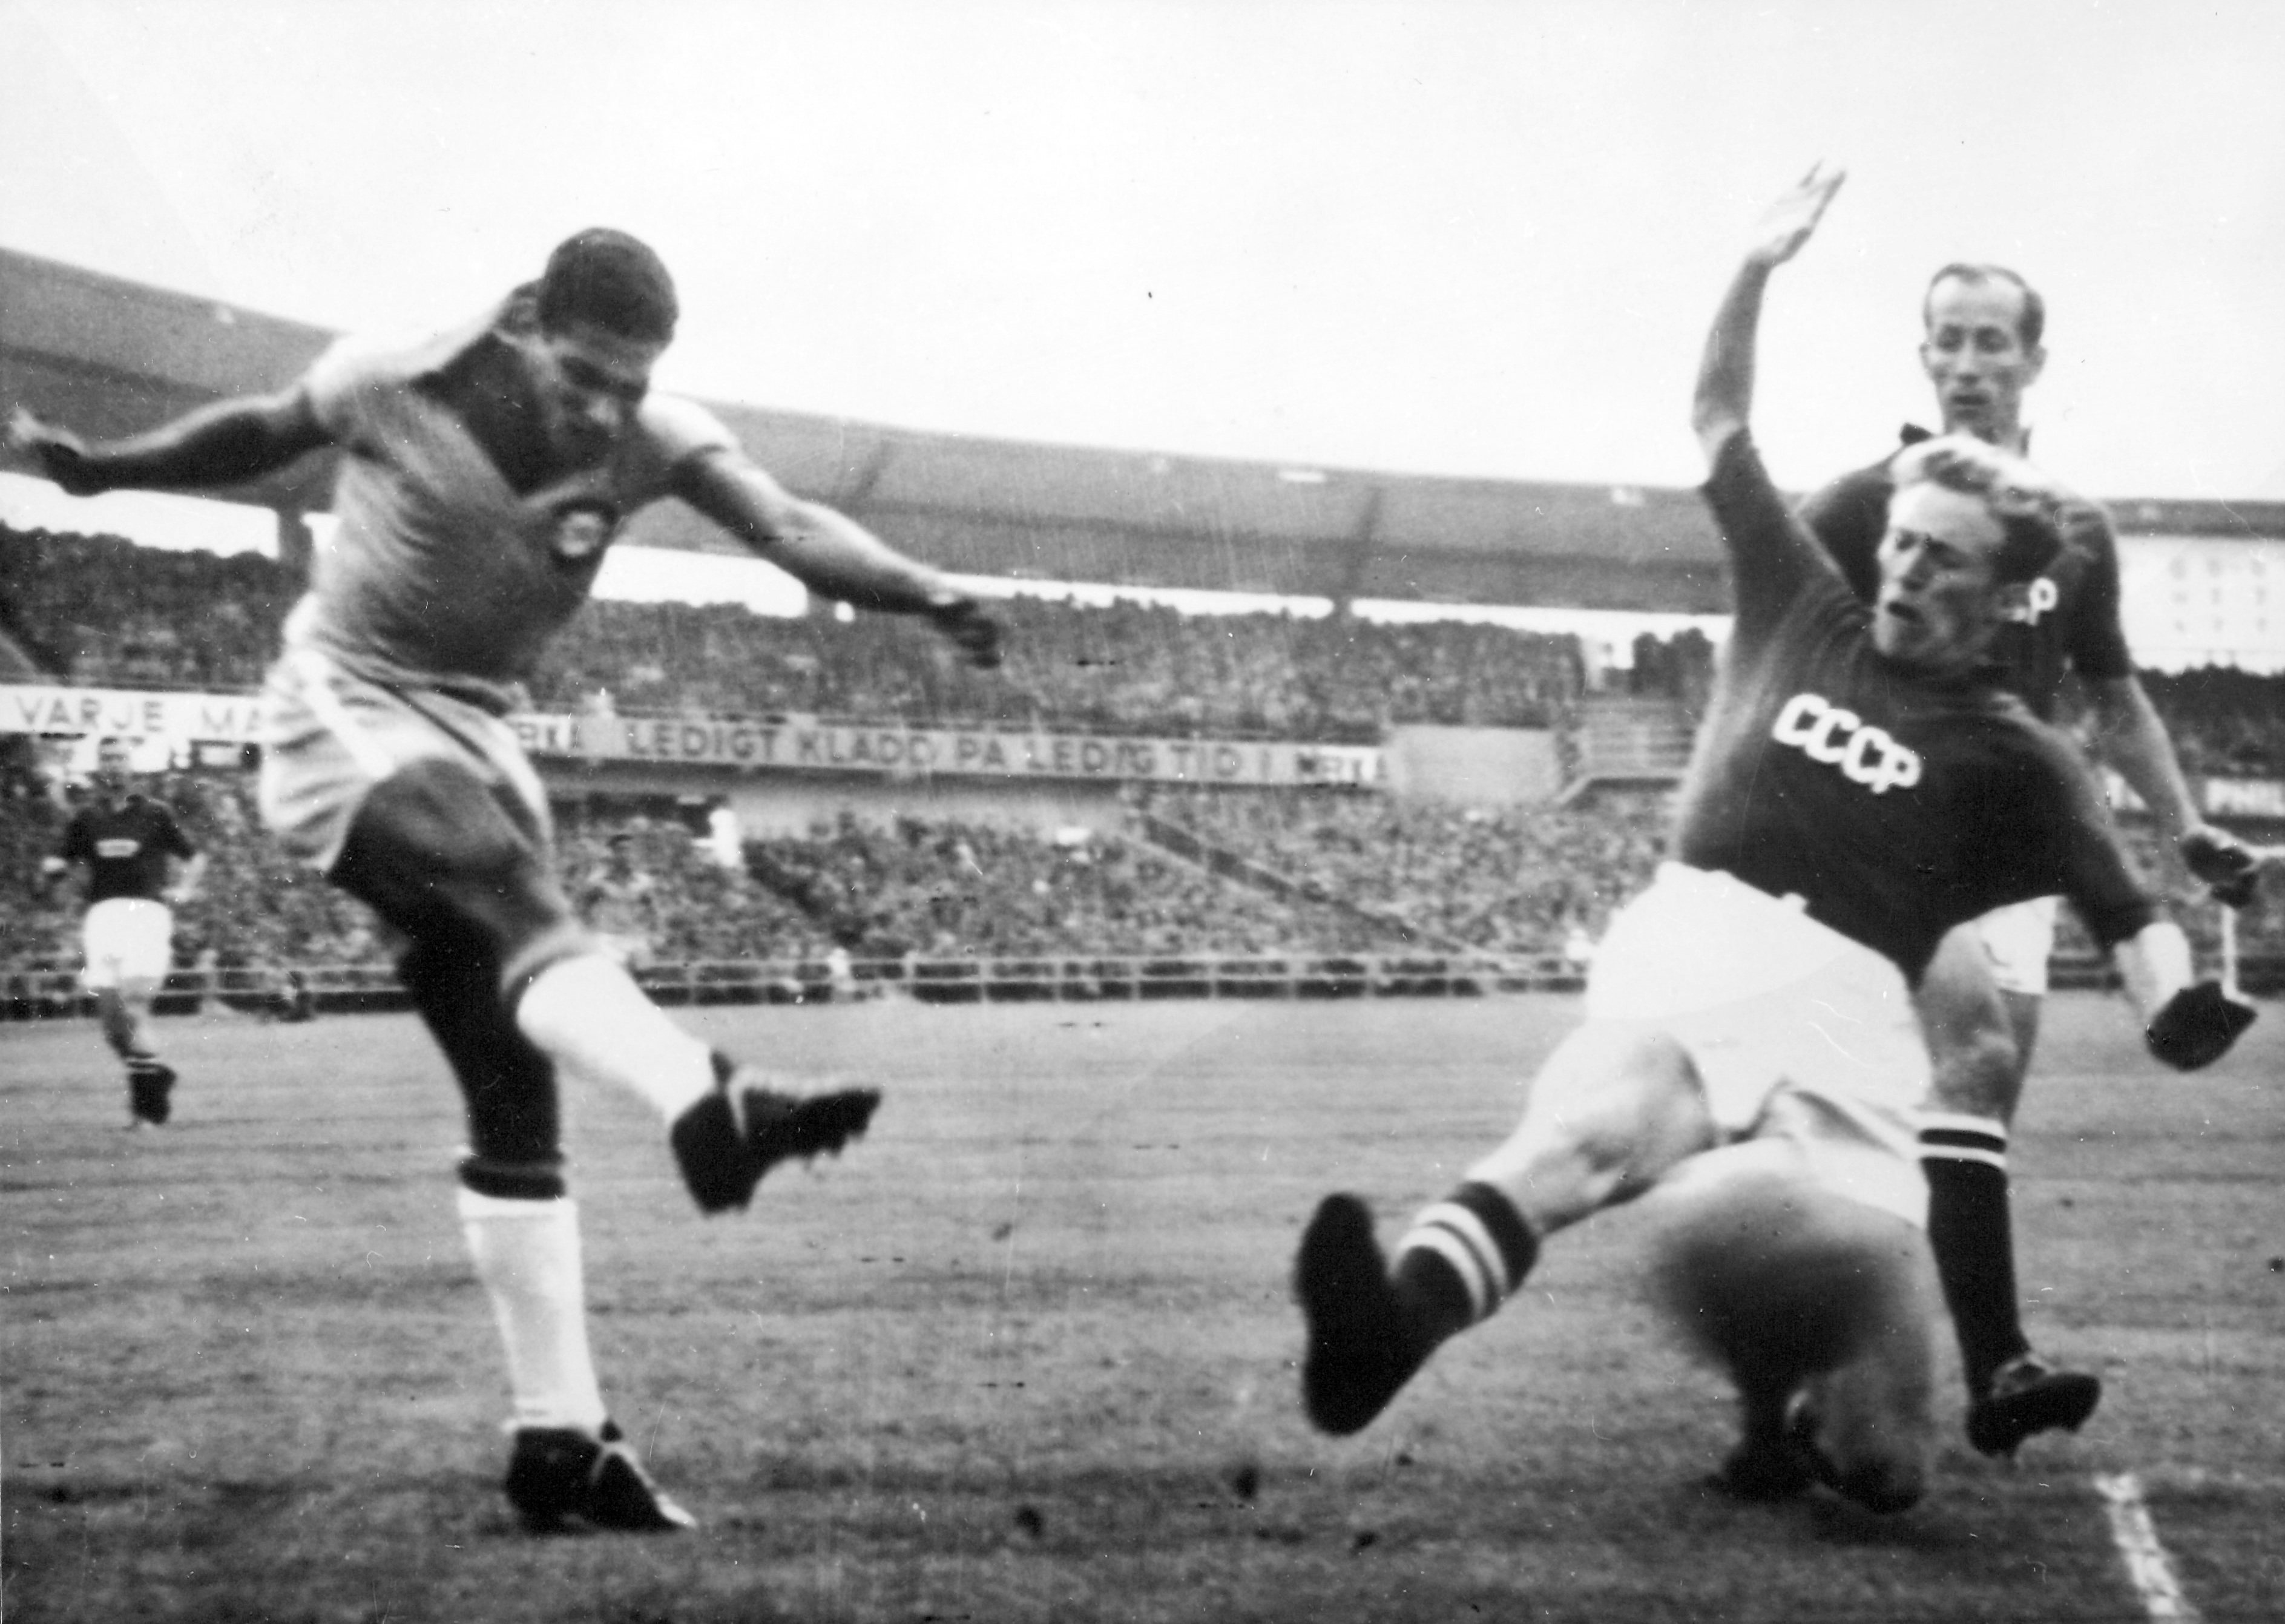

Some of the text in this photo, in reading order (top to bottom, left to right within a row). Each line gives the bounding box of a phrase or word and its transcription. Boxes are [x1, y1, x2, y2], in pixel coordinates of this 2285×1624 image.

[15, 695, 165, 732] VARJE
[627, 727, 780, 761] LEDIGT
[1025, 738, 1156, 774] LEDIG
[1170, 745, 1241, 778] TID
[1772, 692, 1921, 794] СССР
